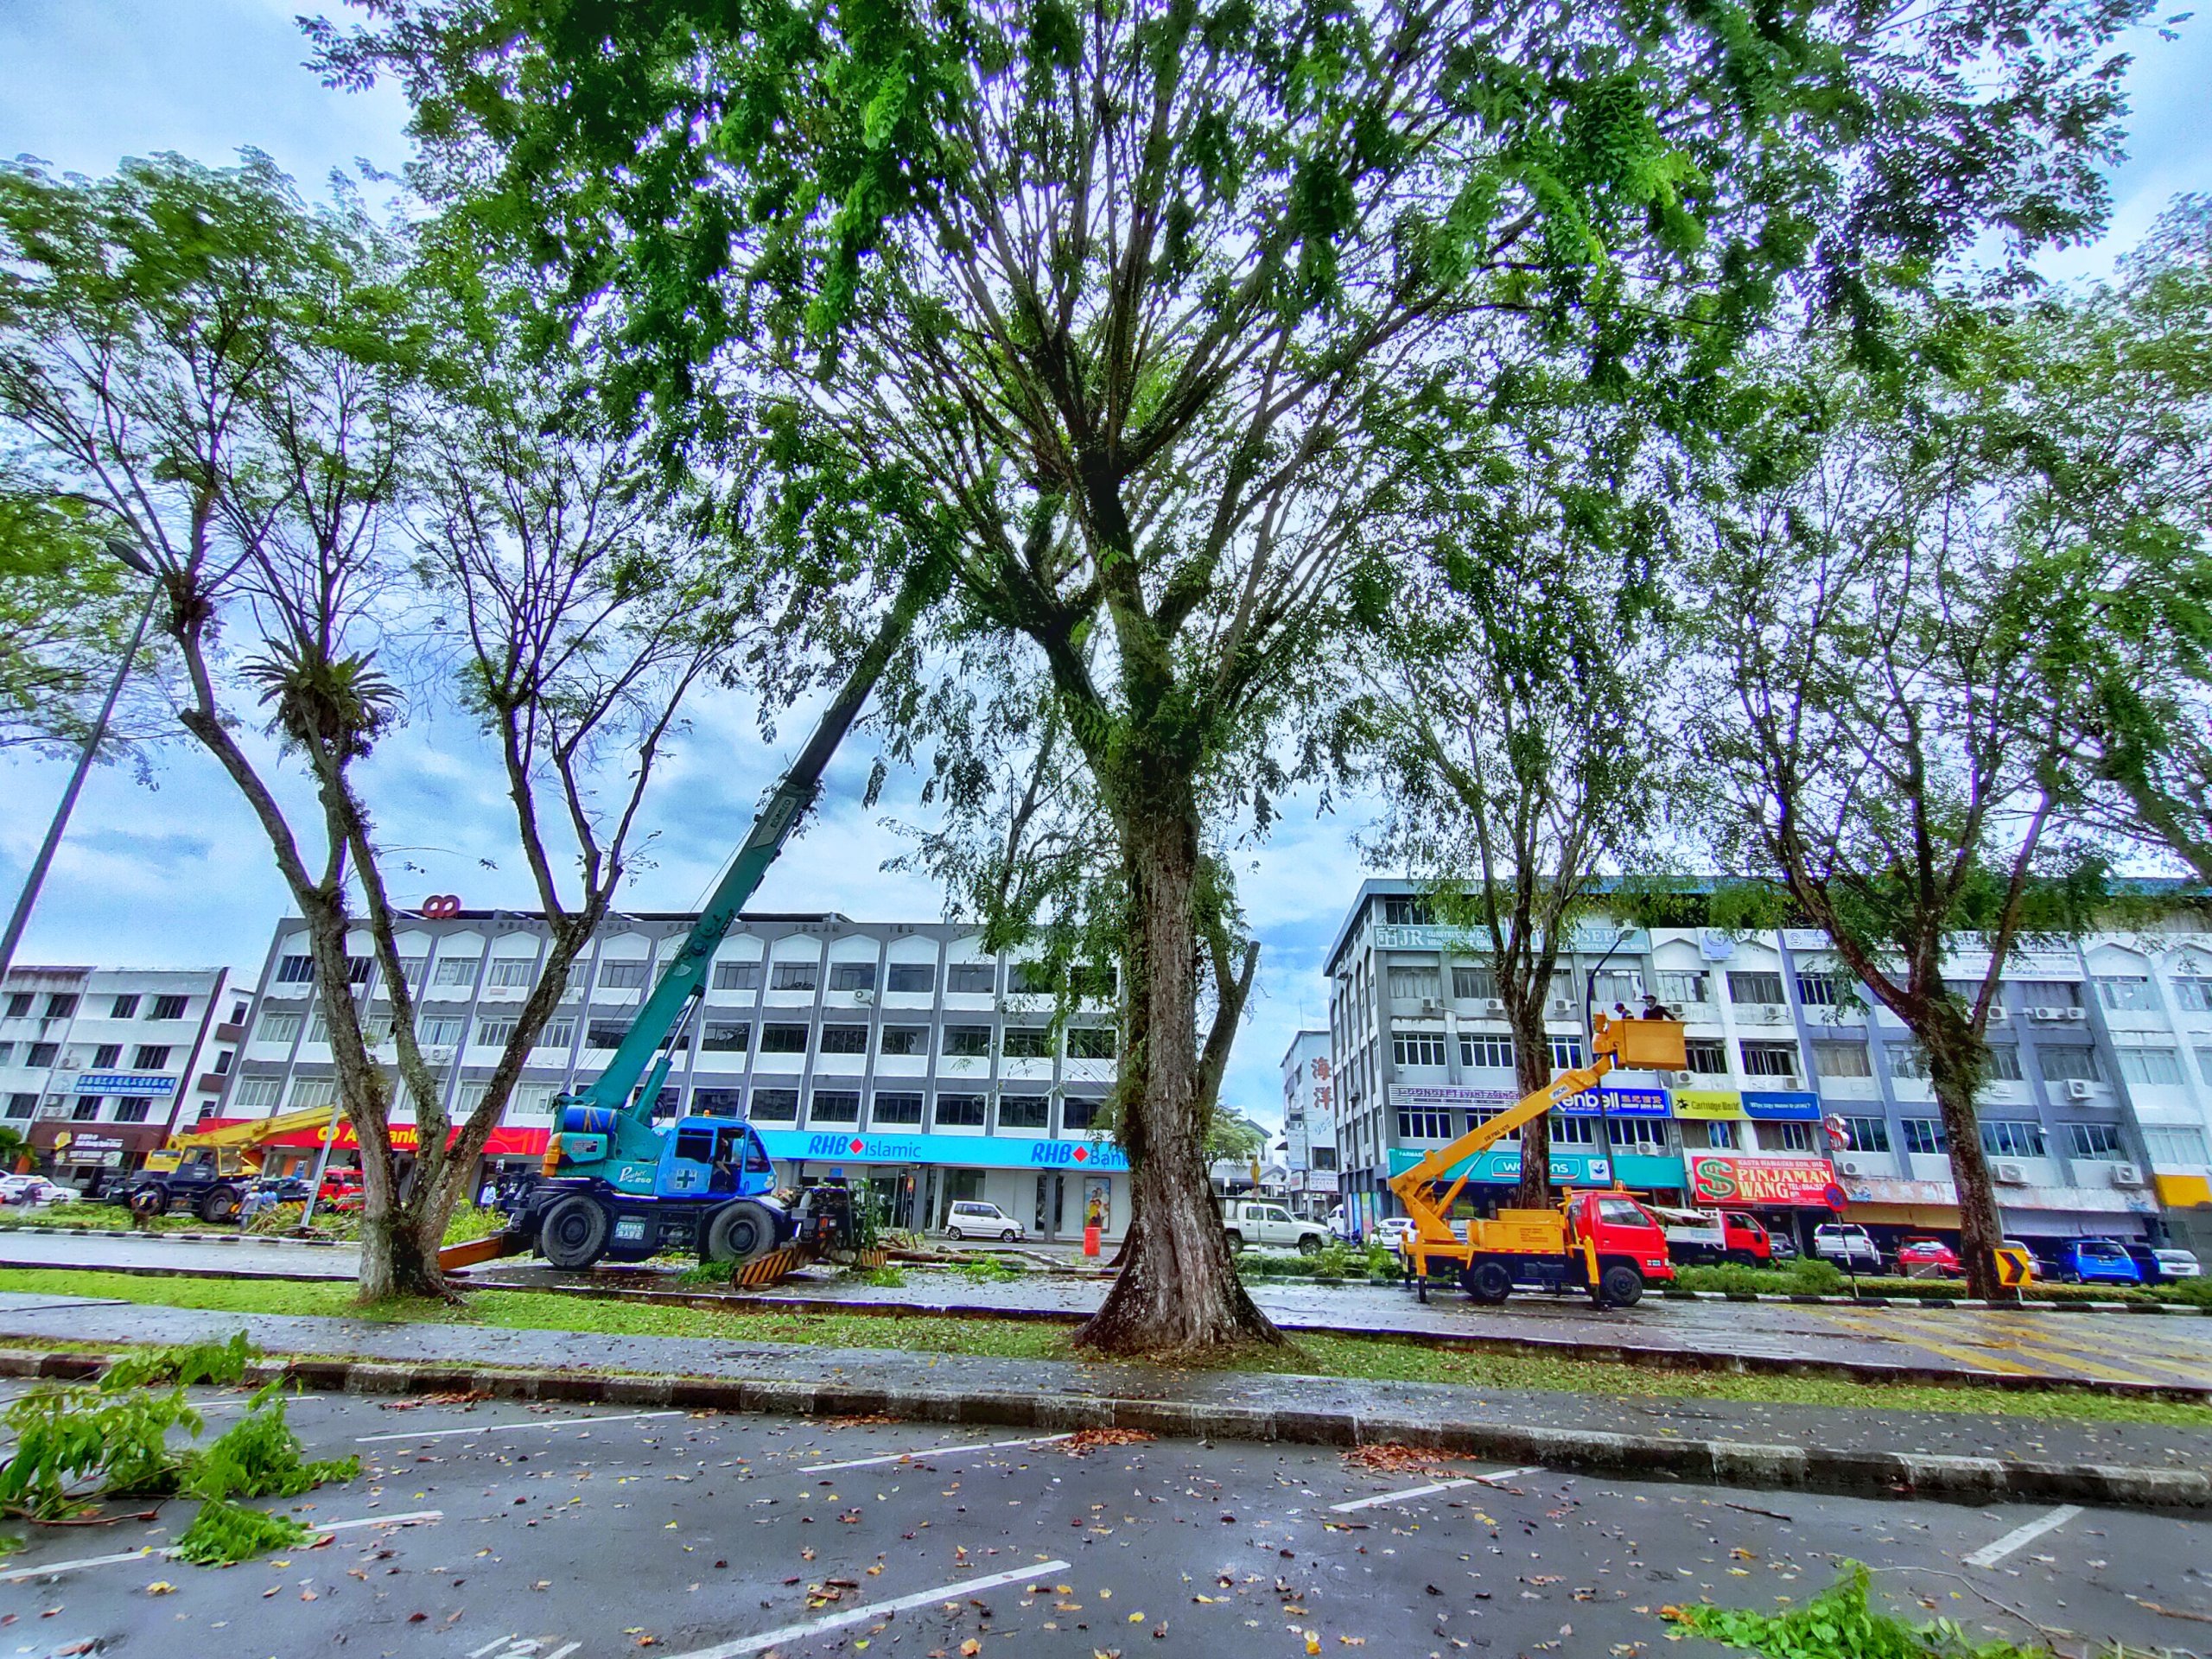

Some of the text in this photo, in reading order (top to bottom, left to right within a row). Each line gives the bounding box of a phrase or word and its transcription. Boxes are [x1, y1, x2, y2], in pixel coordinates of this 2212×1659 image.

[1400, 929, 1425, 945] JR
[1311, 1056, 1333, 1111] 海洋
[1691, 1101, 1739, 1112] Cartridge World
[808, 1135, 922, 1159] RHB Islamic
[1031, 1142, 1072, 1164] RHB
[1736, 1168, 1832, 1184] PINJAMAN
[1738, 1181, 1789, 1198] WANG
